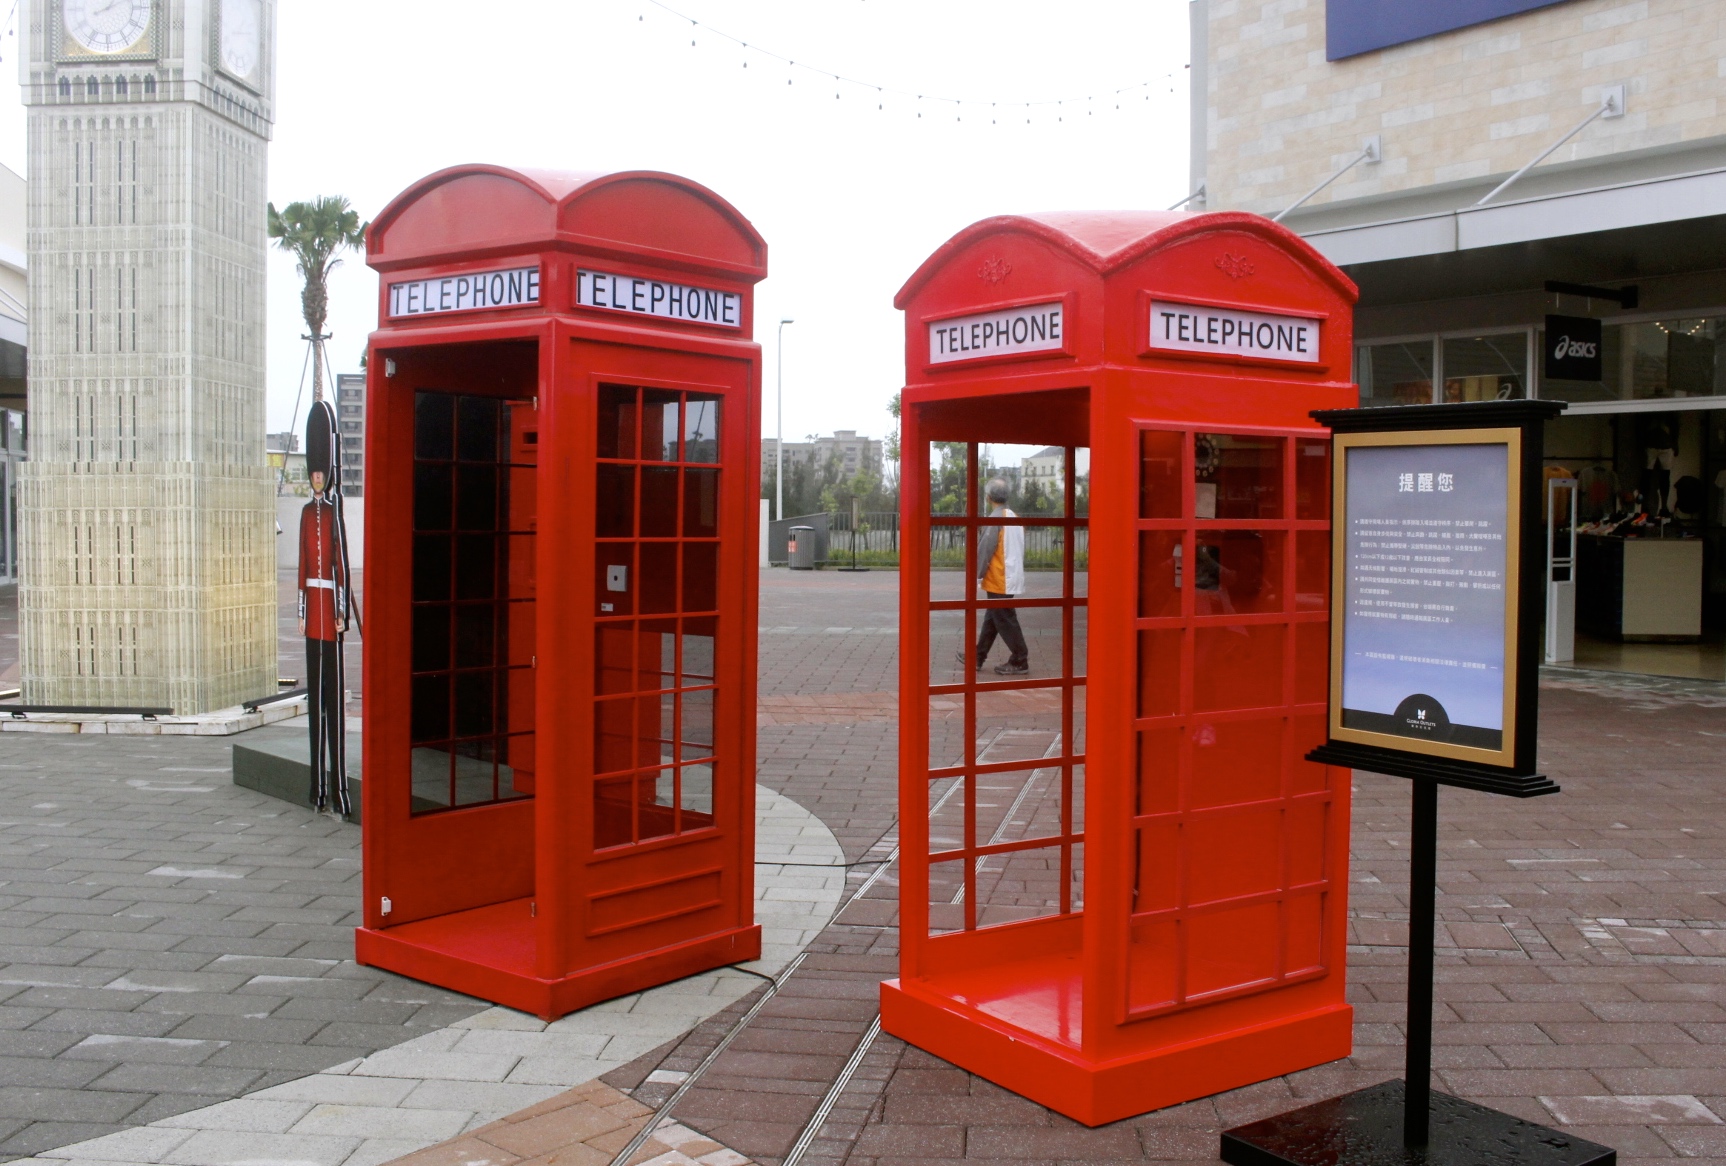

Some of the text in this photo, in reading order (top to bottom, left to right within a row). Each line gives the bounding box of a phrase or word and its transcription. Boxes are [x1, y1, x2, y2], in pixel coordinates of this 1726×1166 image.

[393, 269, 539, 315] TELEPHONE
[576, 271, 735, 323] TELEPHONE
[936, 311, 1061, 355] TELEPHONE
[1160, 311, 1308, 354] TELEPHONE
[1398, 472, 1454, 493] 提醒您
